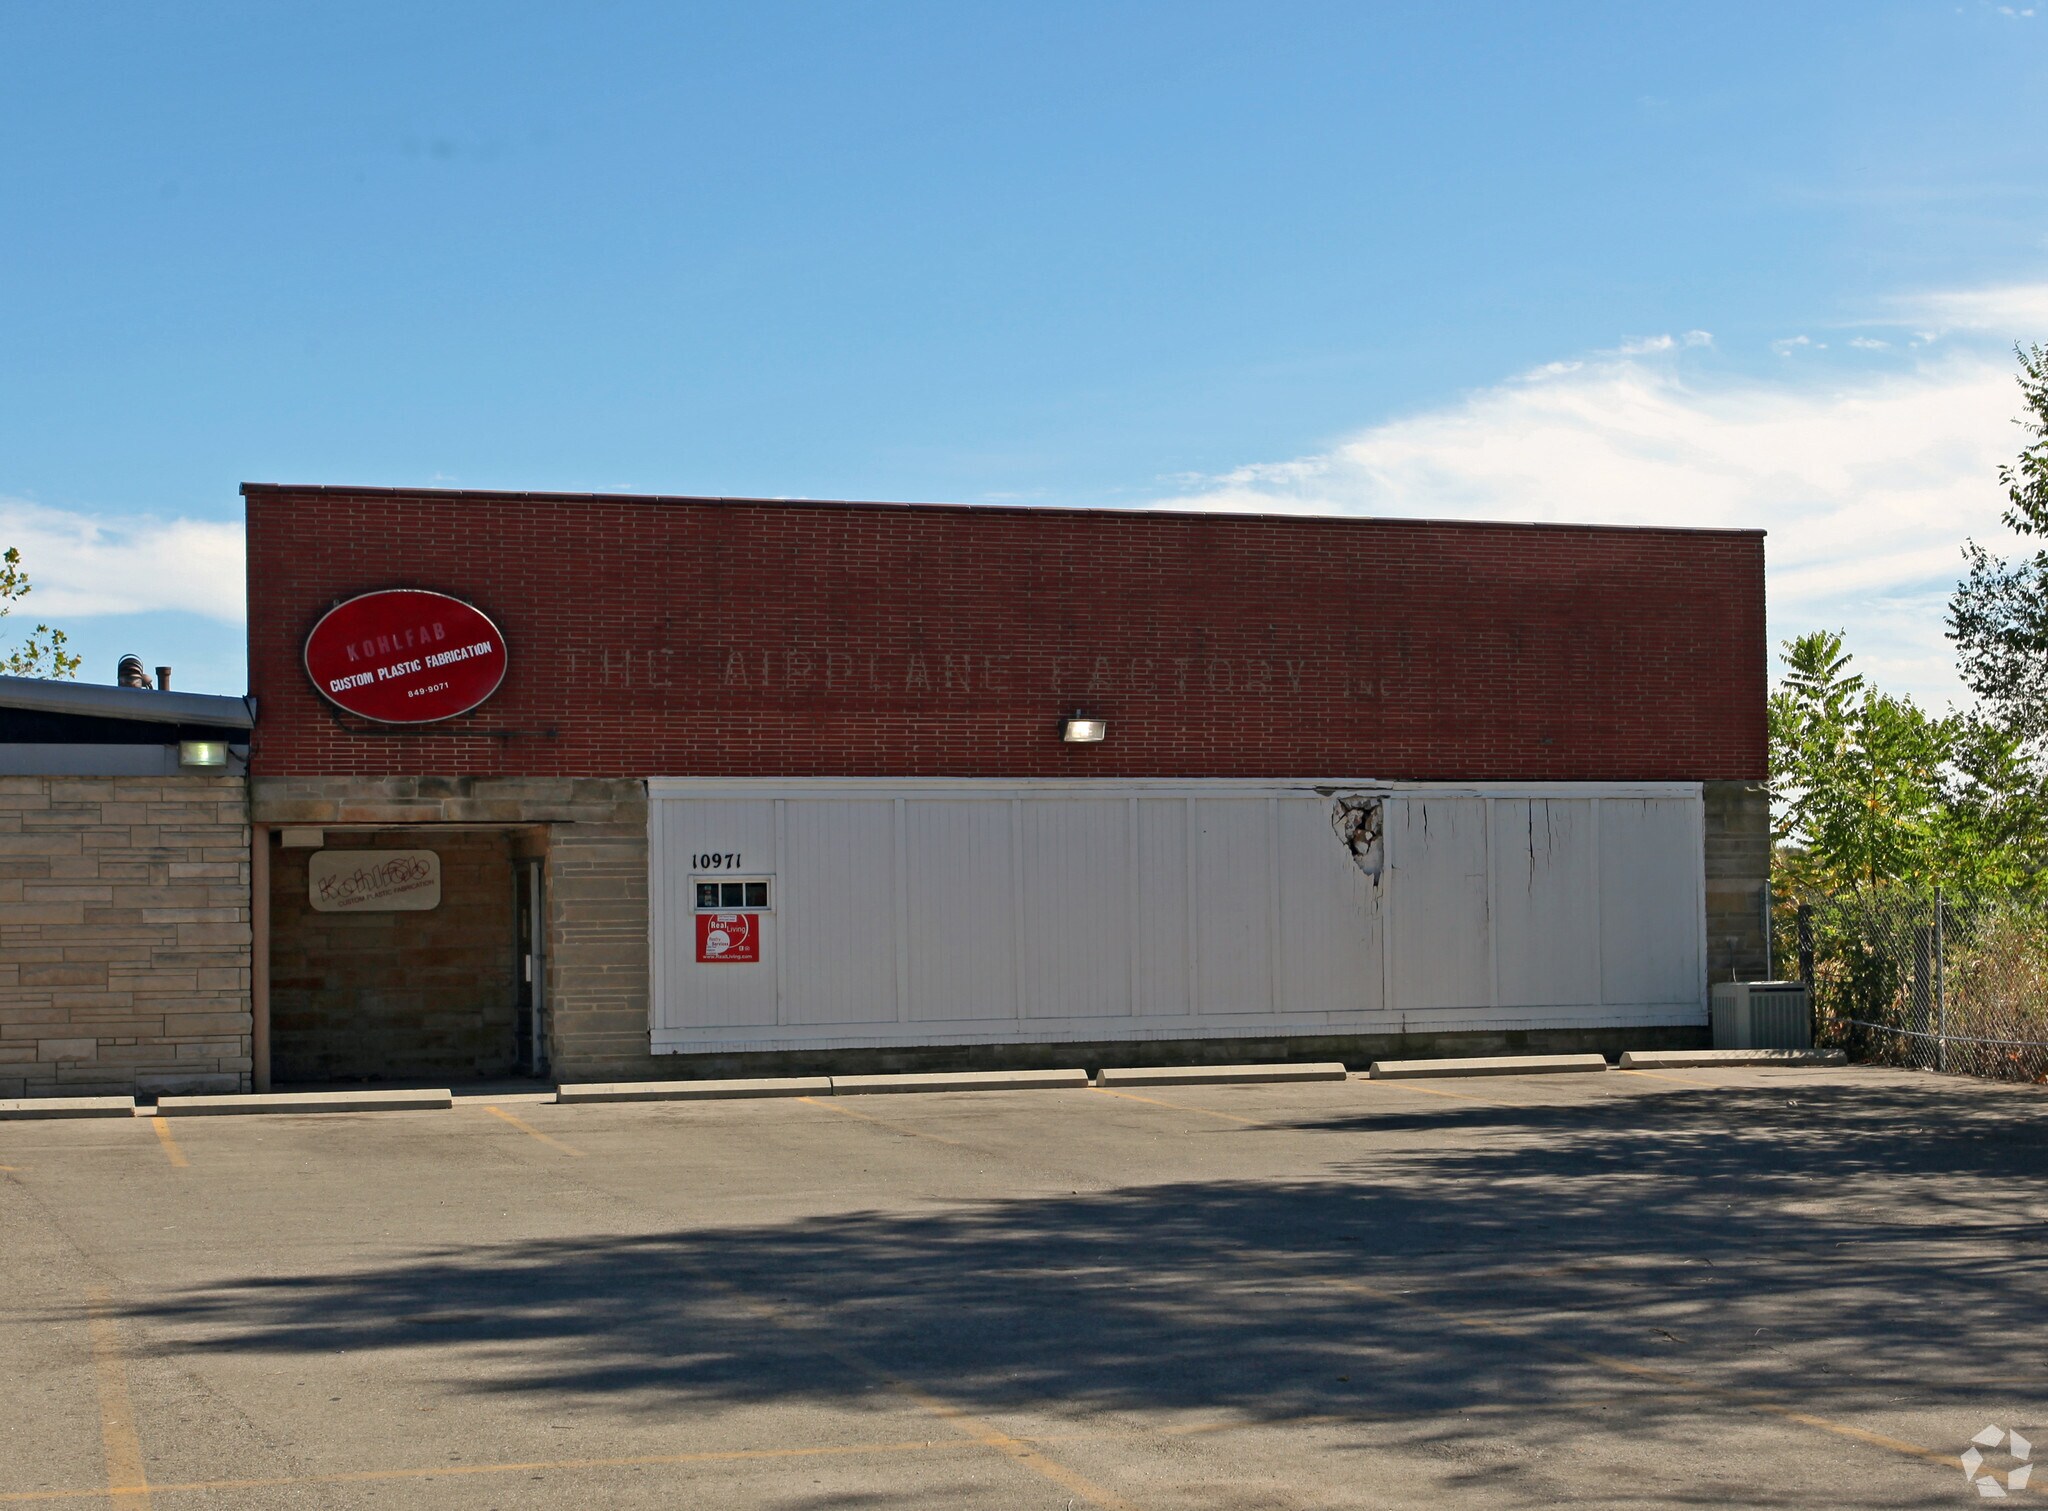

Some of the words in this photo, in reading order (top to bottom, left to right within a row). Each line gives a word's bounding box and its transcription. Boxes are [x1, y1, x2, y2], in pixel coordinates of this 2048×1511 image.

[346, 622, 446, 662] KOHLFAB
[329, 671, 374, 693] CUSTOM
[377, 659, 422, 681] PLASTIC
[425, 641, 493, 669] FABRICATION
[1051, 656, 1305, 695] FACTORY
[692, 853, 742, 870] 10971
[337, 896, 365, 908] CUSTOM
[366, 889, 393, 900] PLASTIC
[393, 879, 435, 893] FABRICATION
[710, 921, 727, 929] Real
[726, 925, 746, 934] Living
